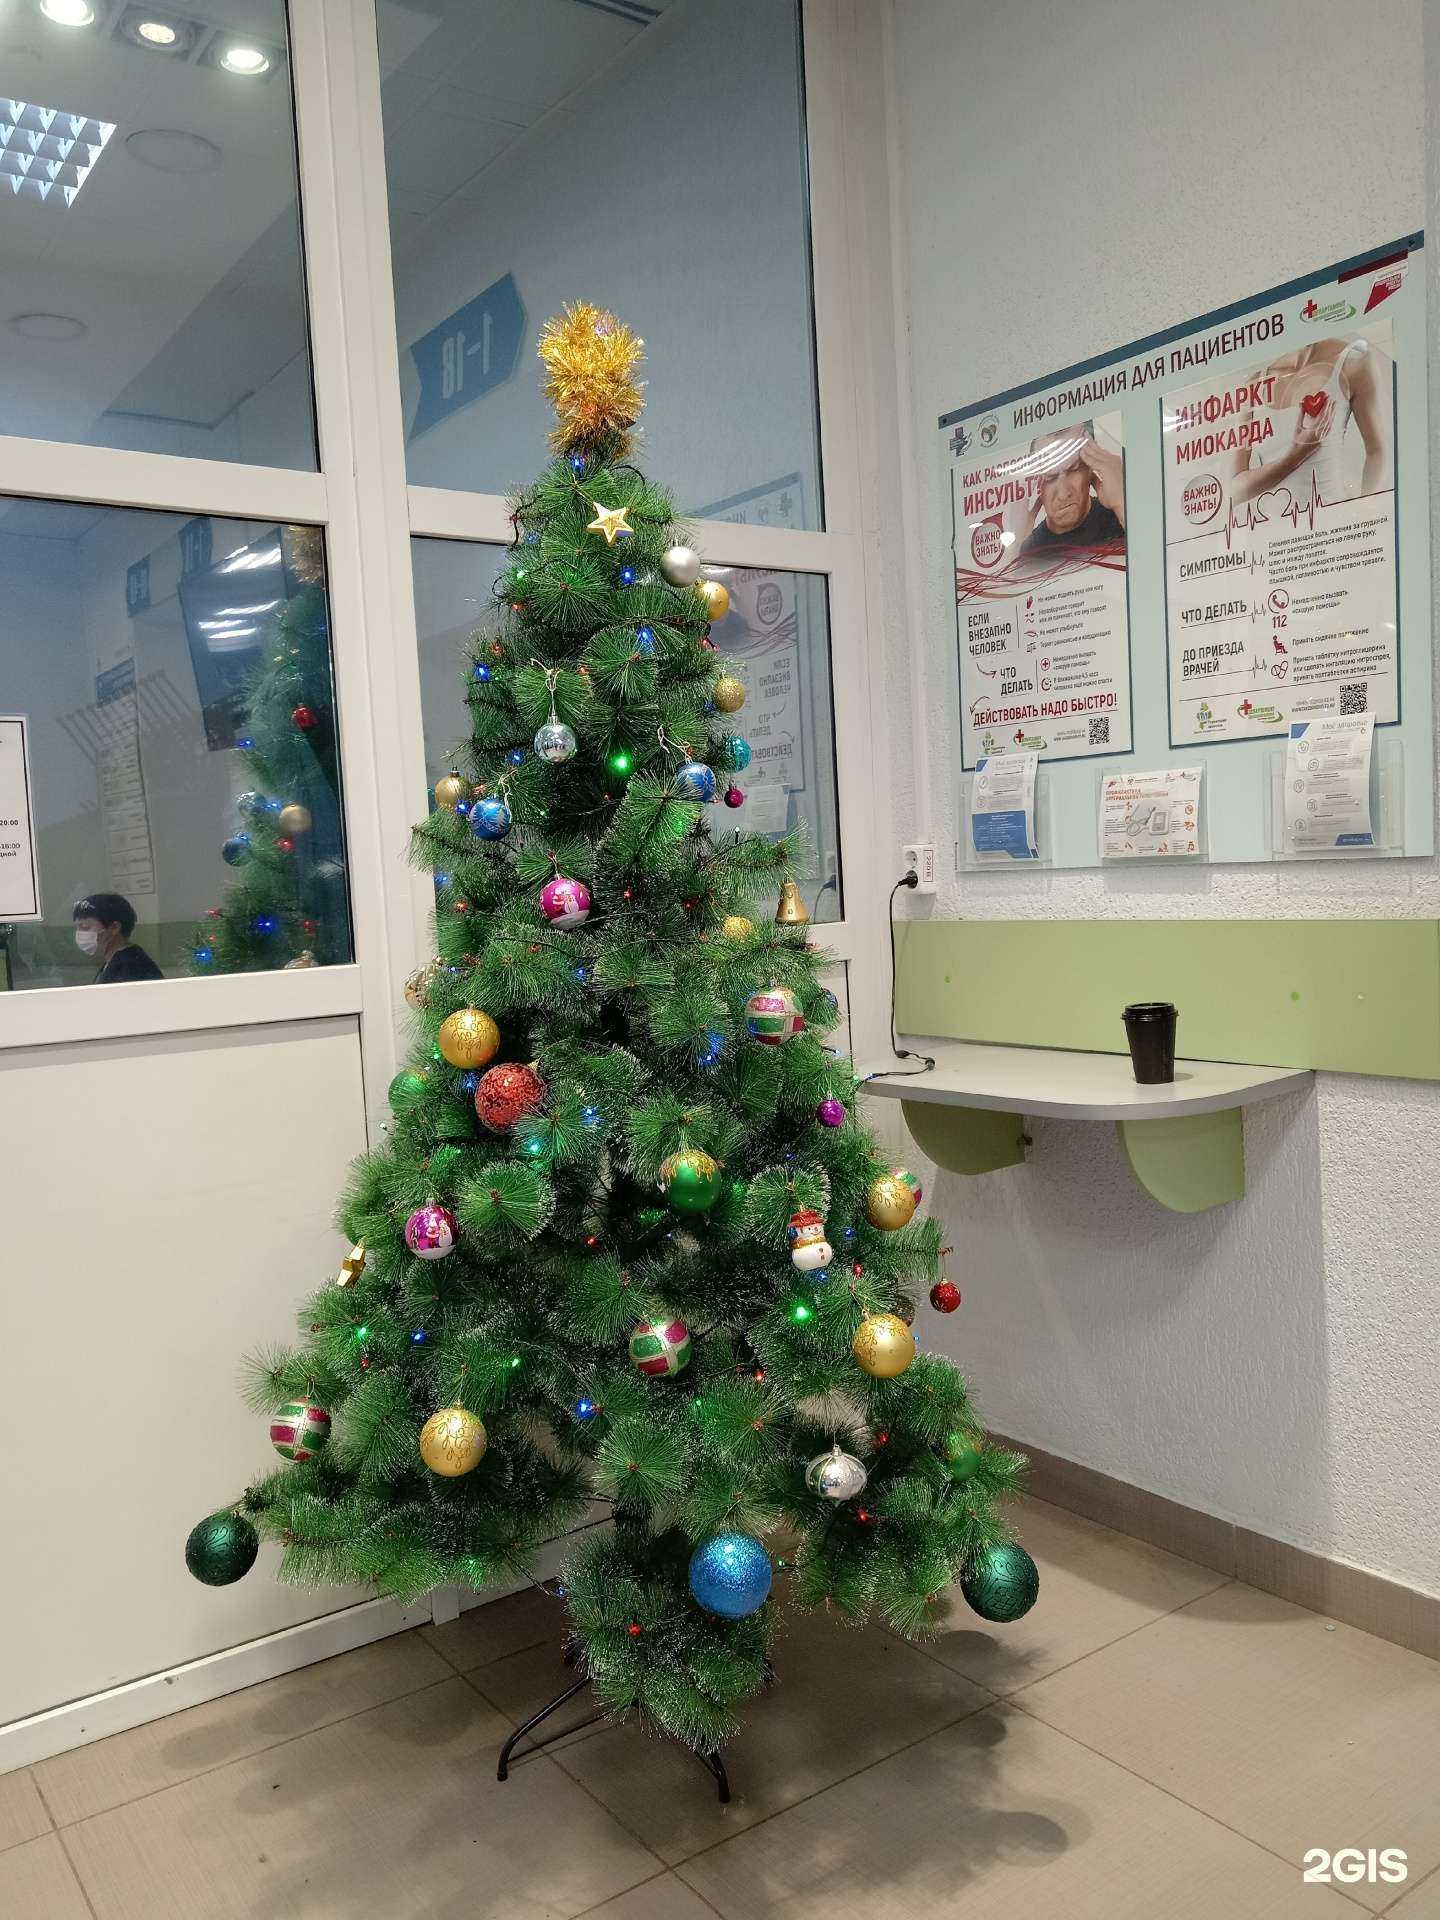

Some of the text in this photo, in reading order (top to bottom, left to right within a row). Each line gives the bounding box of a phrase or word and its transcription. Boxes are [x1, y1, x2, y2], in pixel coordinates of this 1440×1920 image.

[1013, 313, 1285, 430] ИНФОРМАЦИЯ ДЛЯ ПАЦИЕНТОВ
[1175, 376, 1276, 432] ИНФАРКТ
[1176, 417, 1274, 465] МИОКАРДА
[962, 469, 982, 488] КАК
[963, 475, 1046, 516] ИНСУЛЬТ?
[1183, 483, 1217, 502] ВАЖНО
[1184, 497, 1217, 516] ЗНАТЬ!
[975, 529, 1000, 546] ВАЖНО
[976, 541, 1000, 558] ЗНАТЬ!
[1179, 551, 1246, 578] СИМПТОМЫ
[968, 612, 989, 628] ЕСЛИ
[1181, 600, 1248, 624] ЧТО ДЕЛАТЬ
[1272, 614, 1288, 629] 112
[968, 622, 1012, 642] ВНЕЗАПНО
[969, 638, 1007, 656] ЧЕЛОВЕК
[1182, 641, 1245, 663] ДО ПРИЕЗДА
[1000, 666, 1016, 679] ЧТО
[1183, 657, 1220, 677] ВРАЧЕЙ
[1000, 679, 1033, 696] ДЕЛАТЬ
[973, 692, 1118, 727] ДЕЙСТВОВАТЬ НАДО БЫСТРО!
